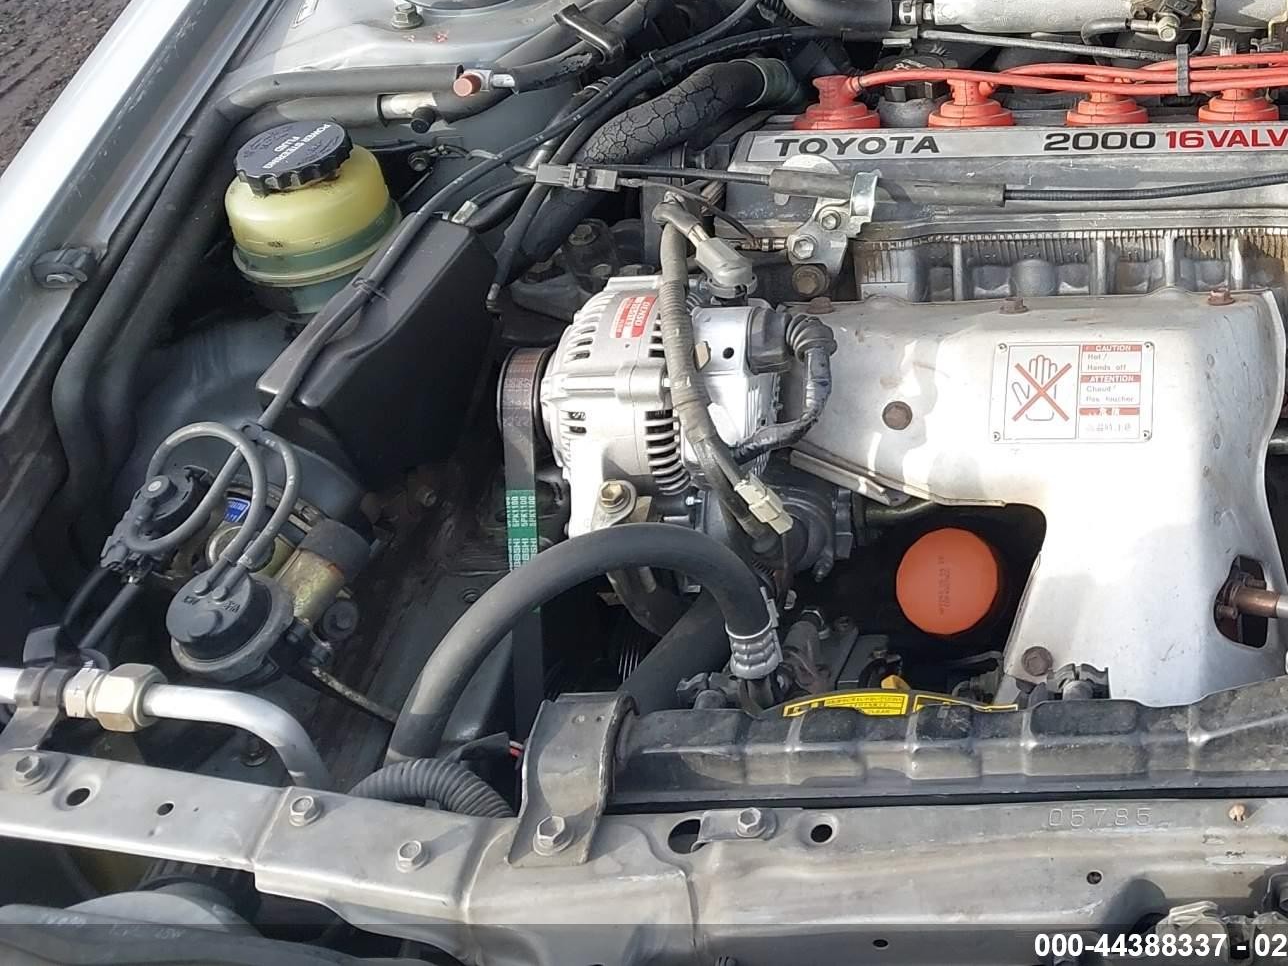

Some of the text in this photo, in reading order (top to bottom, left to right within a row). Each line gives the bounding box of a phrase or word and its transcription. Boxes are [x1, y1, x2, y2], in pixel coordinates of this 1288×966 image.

[301, 123, 331, 143] POWER
[274, 136, 300, 152] FLUID
[774, 136, 940, 156] TOYOTA
[1043, 131, 1156, 151] 2000
[262, 142, 305, 169] STEERING
[1049, 808, 1151, 827] 05785
